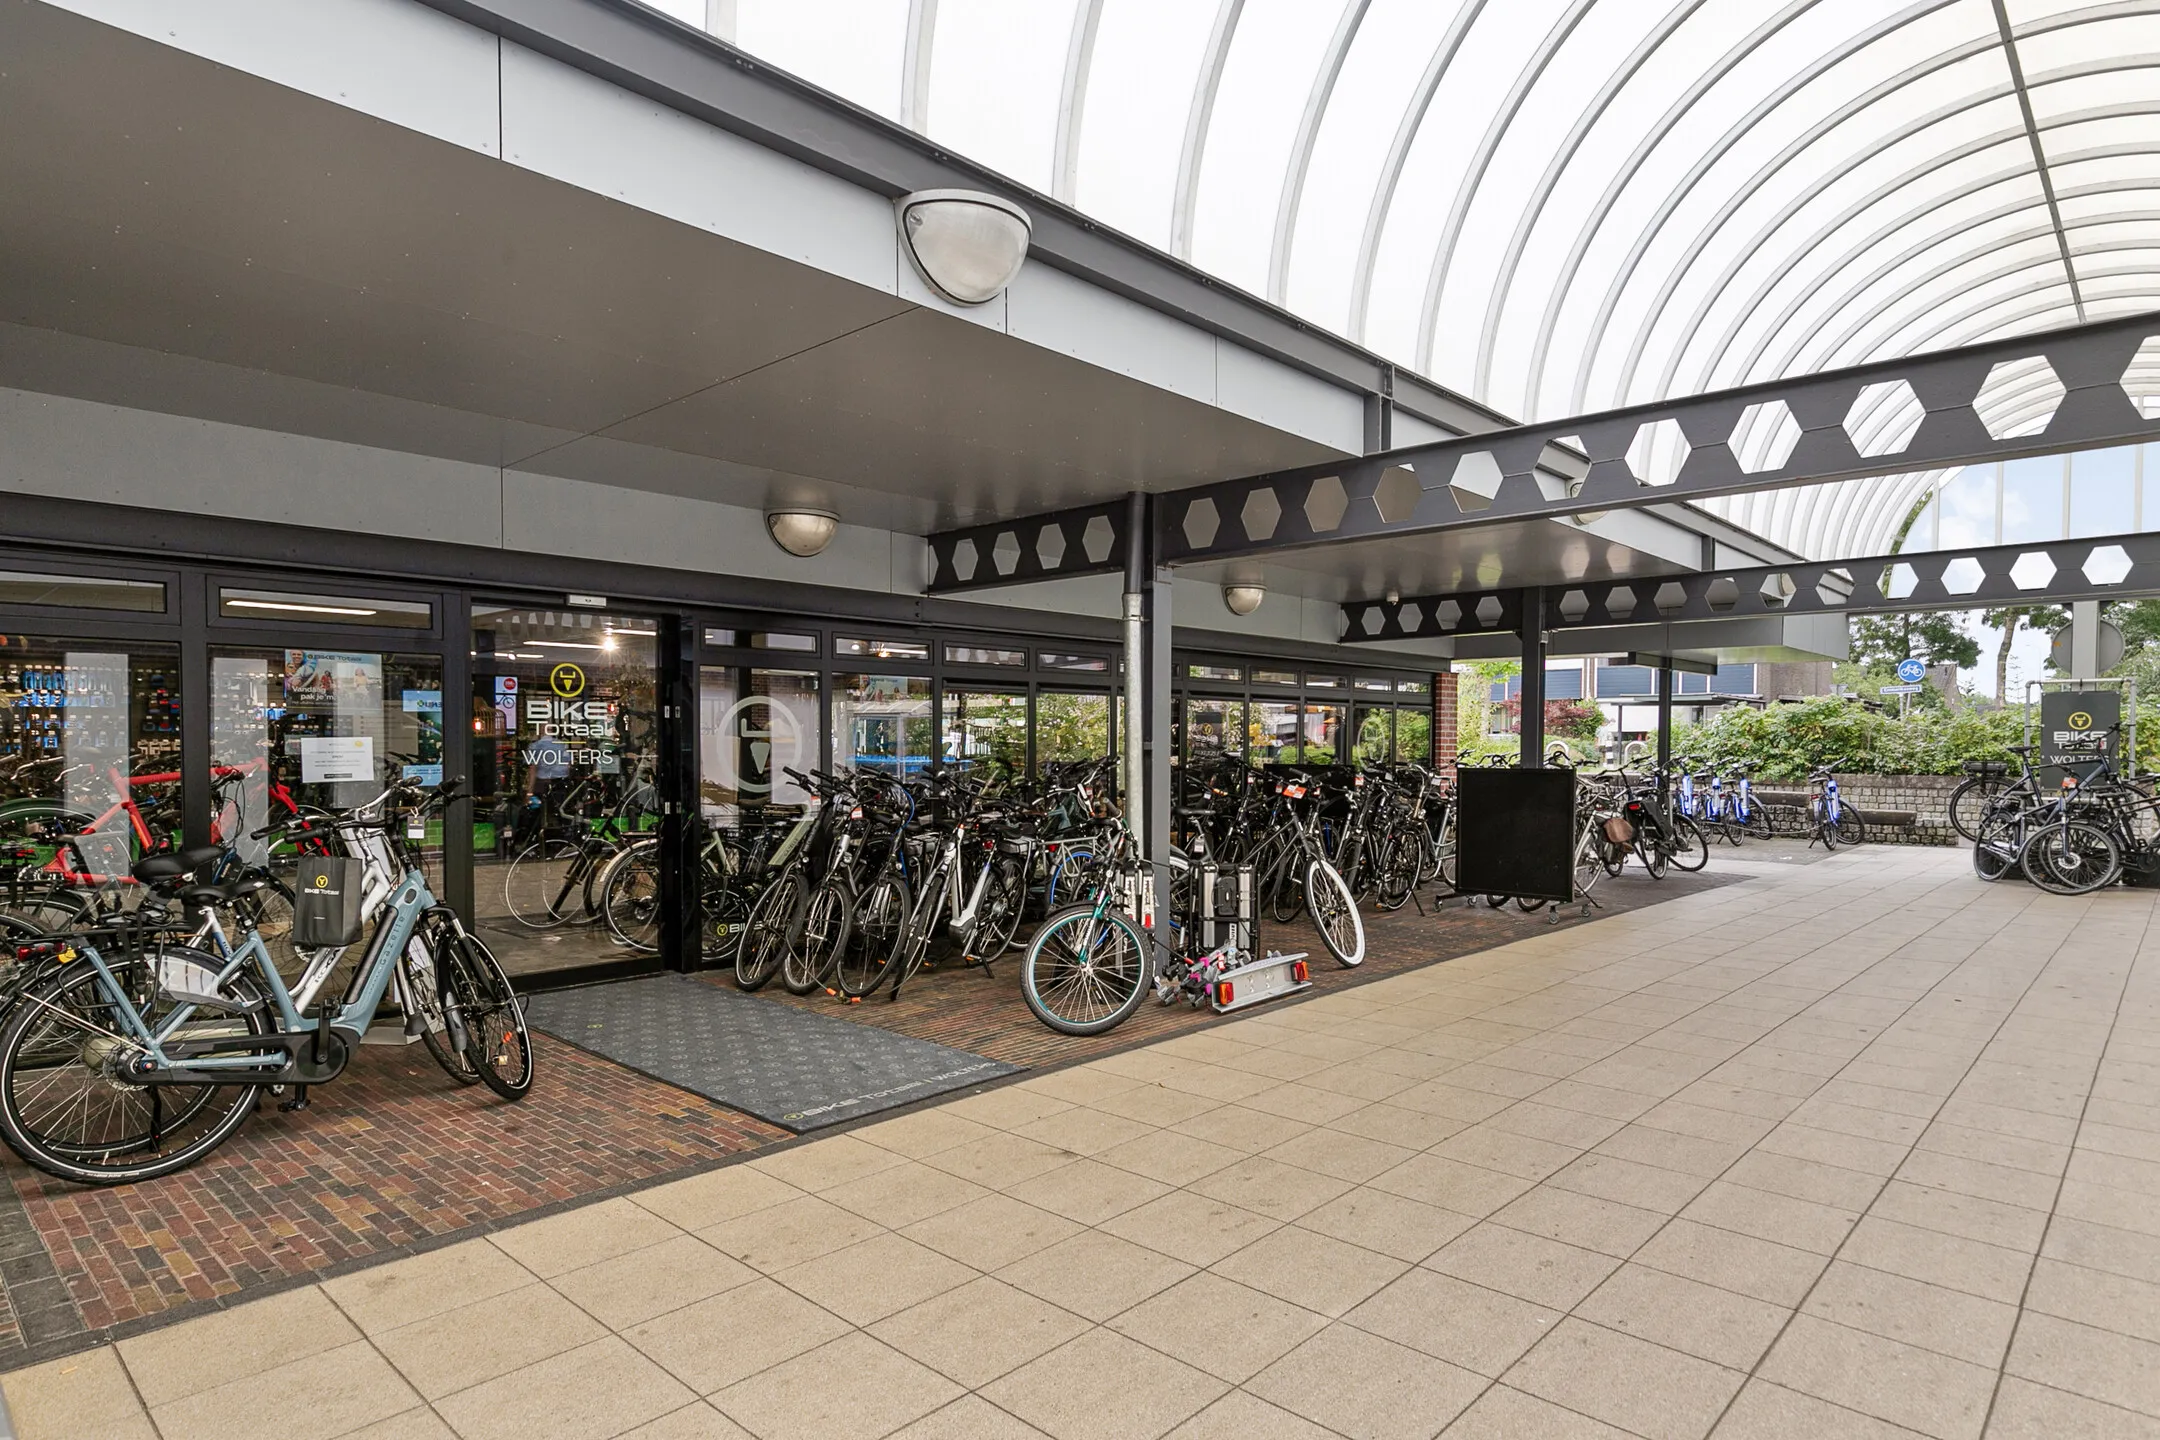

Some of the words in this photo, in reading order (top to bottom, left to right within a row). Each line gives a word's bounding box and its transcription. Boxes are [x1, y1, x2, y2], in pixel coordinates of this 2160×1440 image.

[292, 686, 327, 695] Vandaag
[301, 692, 316, 700] pak
[526, 700, 609, 720] BIKE
[526, 720, 613, 736] Totaal
[2053, 731, 2108, 742] BIKE
[521, 749, 614, 766] WOLTERS
